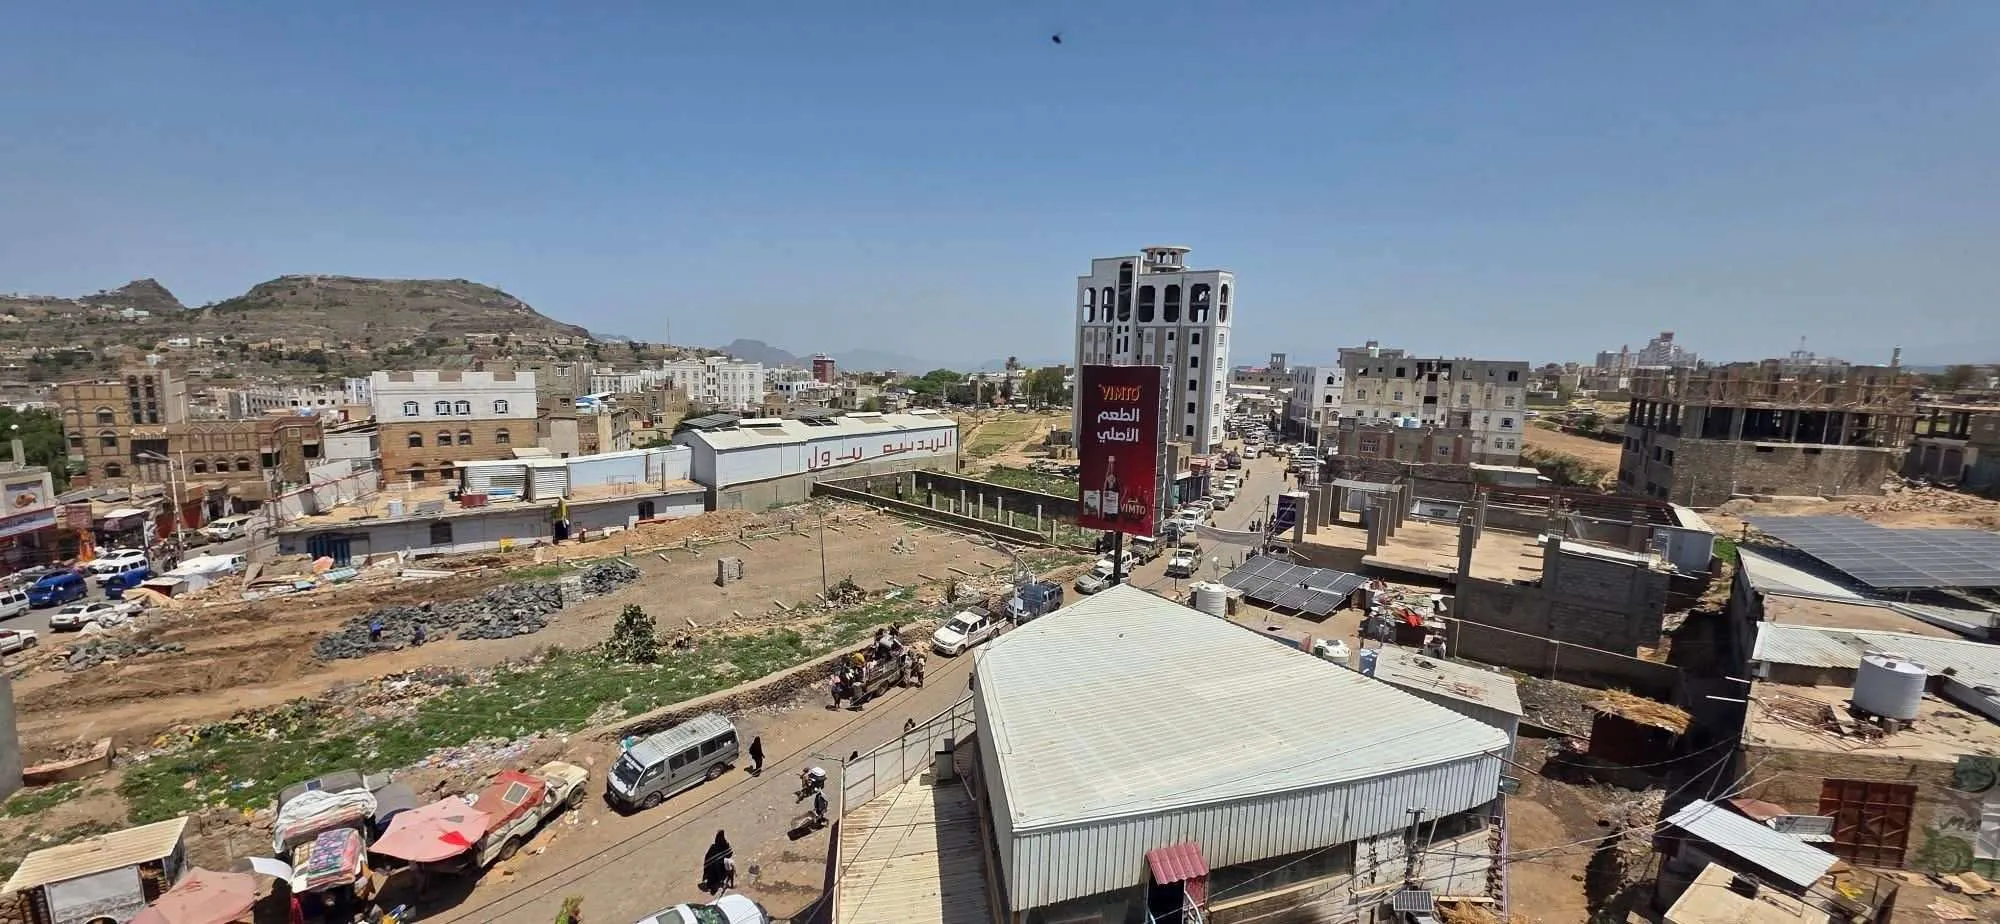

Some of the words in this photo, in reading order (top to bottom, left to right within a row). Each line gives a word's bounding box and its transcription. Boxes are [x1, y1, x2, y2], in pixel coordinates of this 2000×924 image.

[1101, 385, 1141, 401] VIMTO
[1097, 407, 1139, 423] الطعم
[1097, 426, 1139, 443] الأصلي
[1120, 503, 1146, 515] VIMTO
